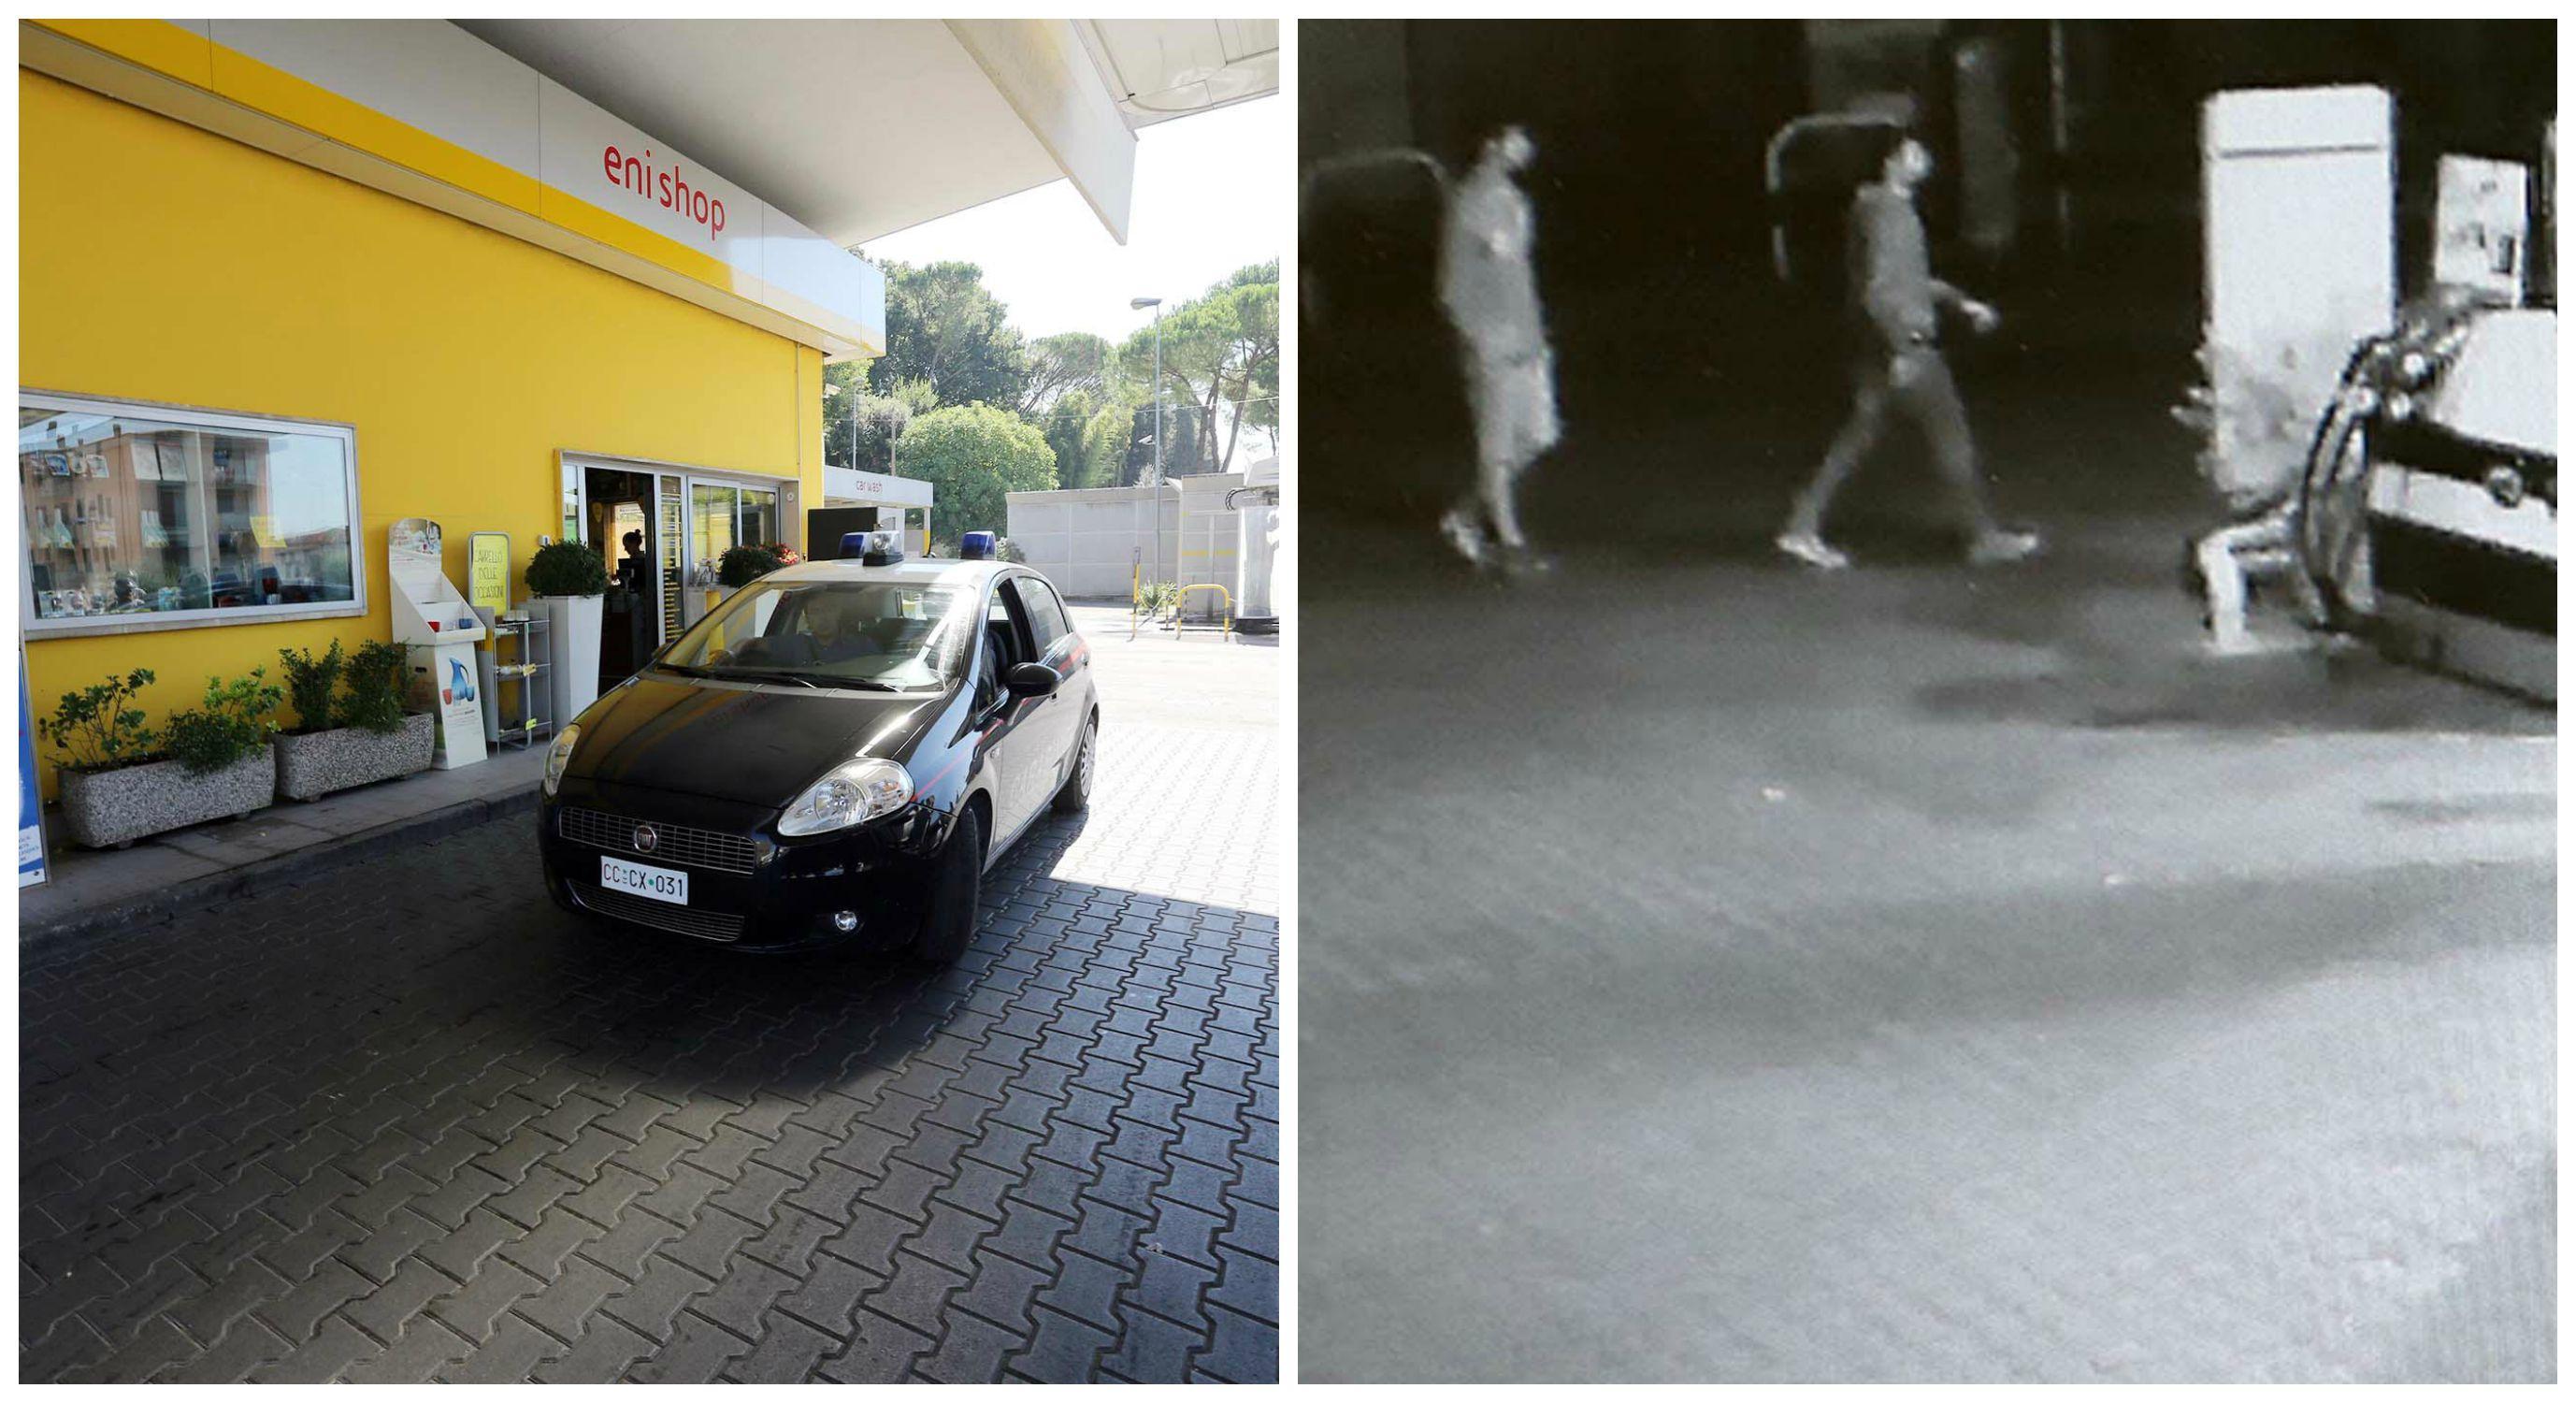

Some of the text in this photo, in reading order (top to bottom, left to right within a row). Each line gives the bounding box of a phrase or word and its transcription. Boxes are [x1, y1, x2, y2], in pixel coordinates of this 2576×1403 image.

[604, 146, 726, 241] eni shop
[856, 480, 884, 494] car wash
